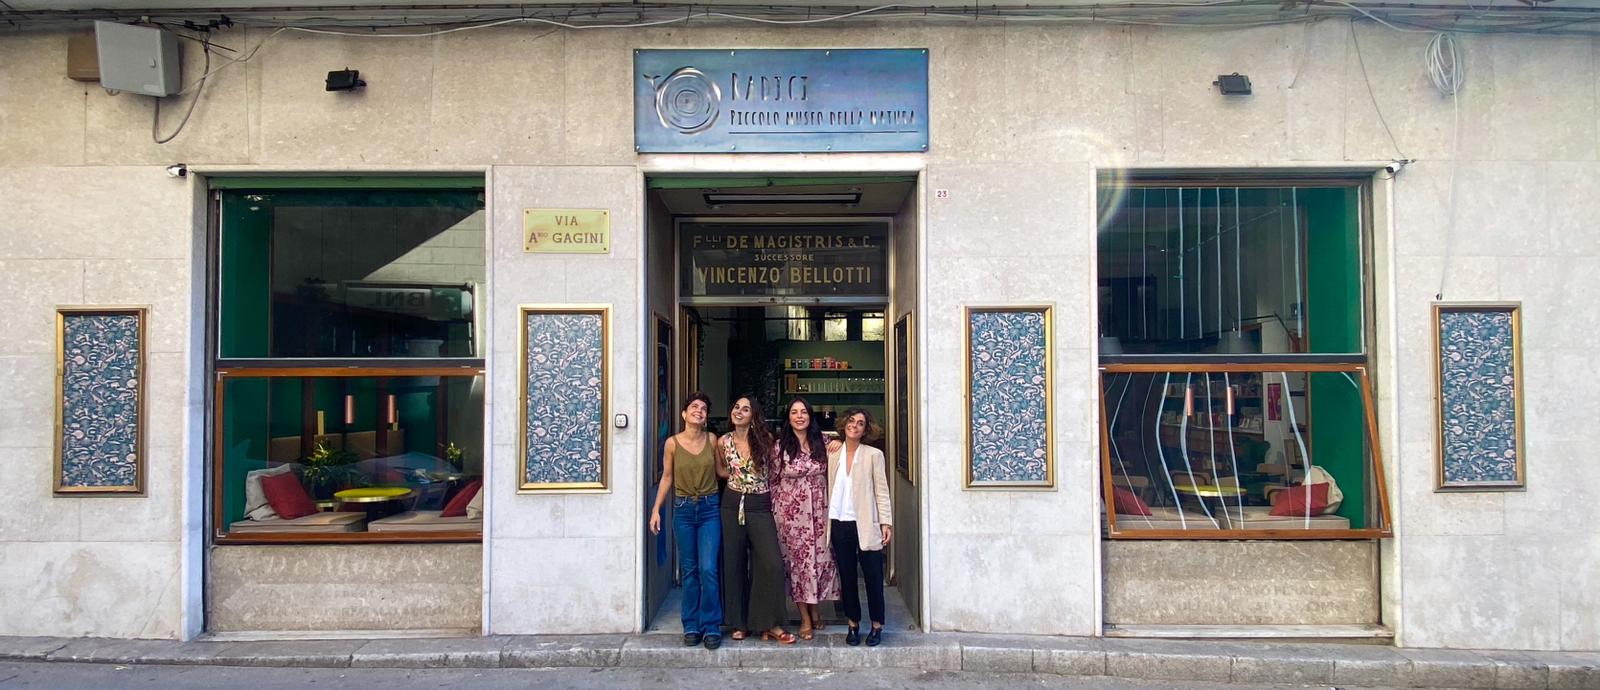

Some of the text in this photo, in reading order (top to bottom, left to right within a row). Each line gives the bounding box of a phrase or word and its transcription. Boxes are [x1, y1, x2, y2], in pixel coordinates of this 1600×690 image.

[731, 72, 808, 101] RADICI
[730, 110, 780, 126] PICCOLO
[785, 110, 824, 126] MUSEO
[829, 110, 864, 126] DELLA
[936, 190, 948, 198] 23
[555, 215, 579, 226] VIA
[552, 232, 604, 244] GAGINI
[726, 235, 749, 249] DE
[754, 235, 844, 249] MAGISTRIS
[847, 238, 857, 248] &
[754, 253, 815, 262] SUCCESSORE
[699, 266, 871, 284] VINCENZO BELLOTTI
